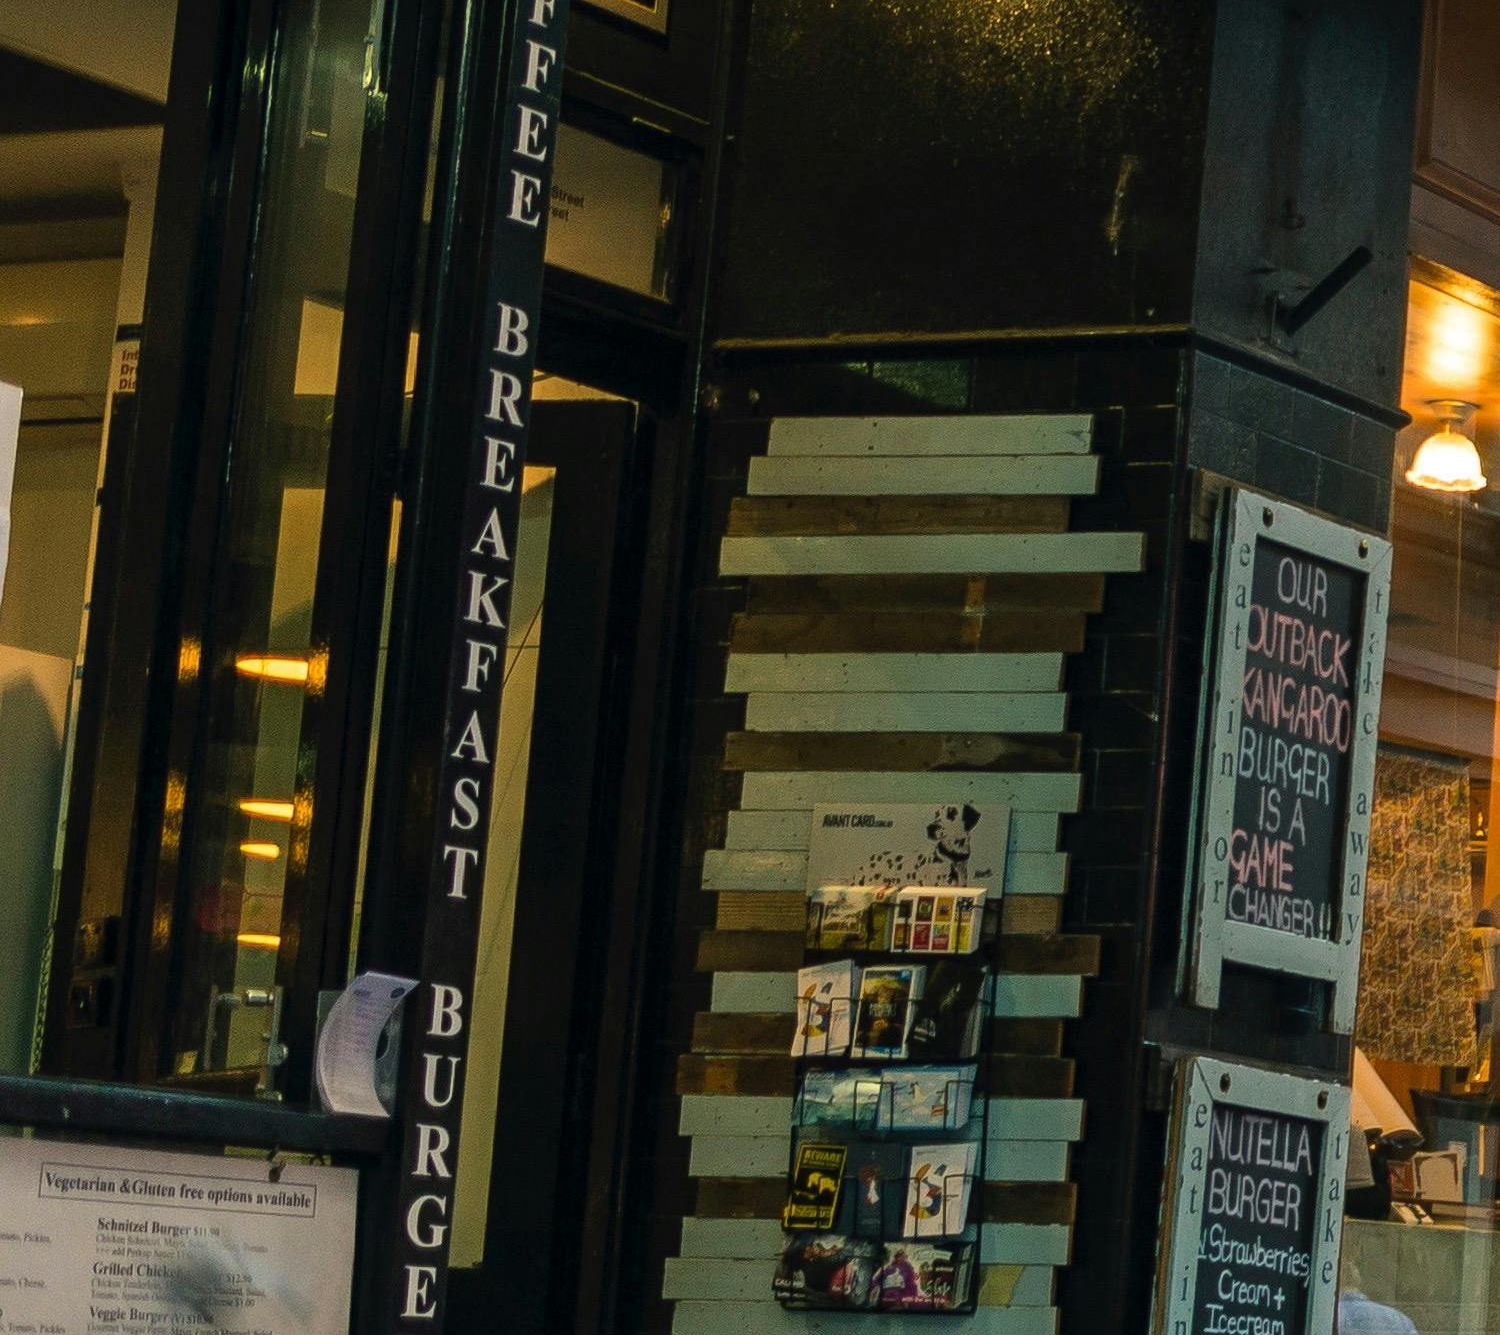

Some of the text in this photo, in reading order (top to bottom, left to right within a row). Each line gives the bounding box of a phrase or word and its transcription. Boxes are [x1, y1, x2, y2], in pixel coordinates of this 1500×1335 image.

[443, 302, 531, 901] BREAKFAST
[1277, 555, 1329, 620] OUR
[1247, 602, 1353, 690] OUTBACK
[1241, 665, 1353, 755] KANGAROO
[1237, 725, 1331, 806] BURGER
[1257, 786, 1307, 848] IS A
[1230, 827, 1296, 894] GAME
[1208, 1113, 1314, 1178] NUTELLA
[46, 1171, 116, 1194] Vegetarian
[180, 1182, 205, 1201] free
[207, 1187, 253, 1206] options
[256, 1191, 311, 1209] available
[1208, 1167, 1301, 1232] BURGER
[97, 1216, 149, 1234] Schnitzel
[151, 1219, 191, 1237] Burger
[92, 1261, 134, 1278] Grilled
[1217, 1268, 1271, 1311] Cream
[89, 1305, 127, 1323] Veggie
[129, 1307, 170, 1327] Burger
